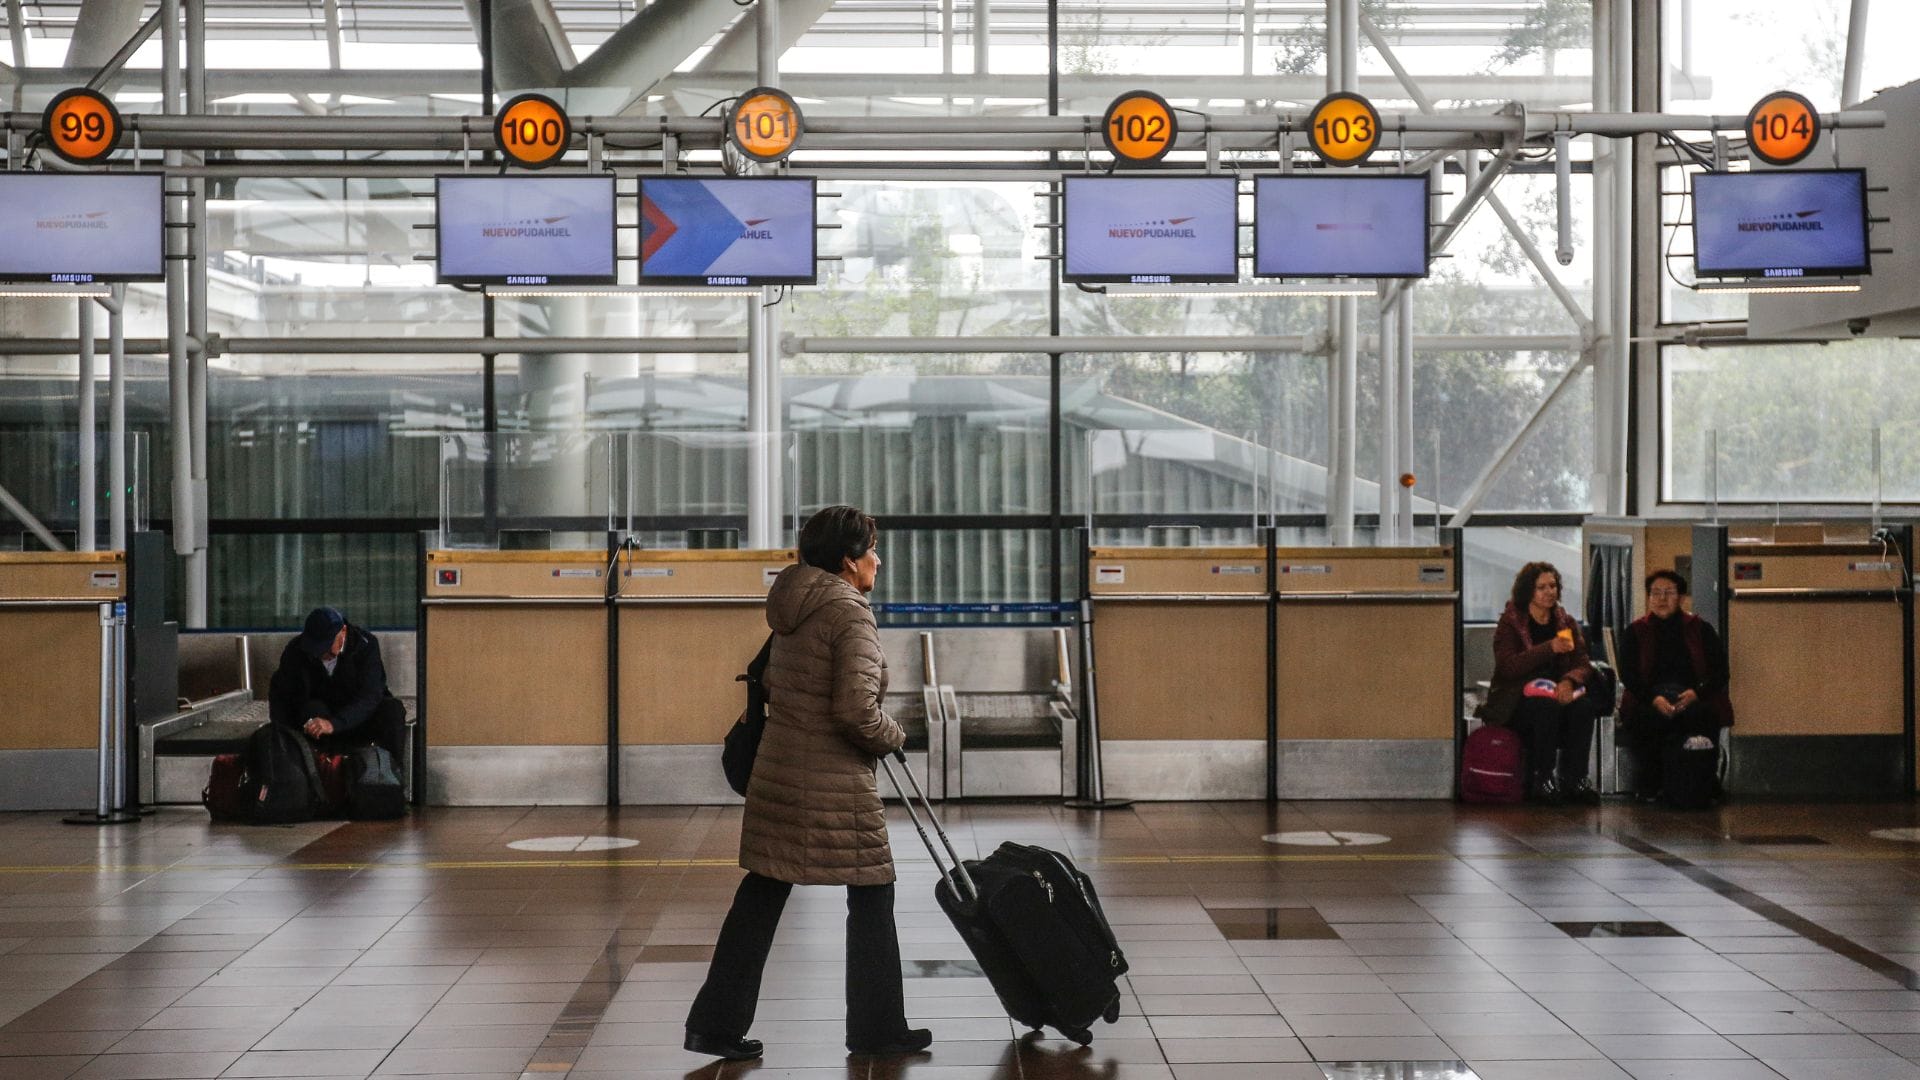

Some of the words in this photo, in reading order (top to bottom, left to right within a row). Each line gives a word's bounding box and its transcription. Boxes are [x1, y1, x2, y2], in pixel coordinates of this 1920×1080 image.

[60, 112, 105, 142] 99
[738, 112, 790, 139] 101
[1111, 114, 1165, 143] 102
[1316, 115, 1373, 145] 103
[1755, 114, 1809, 141] 104
[505, 118, 560, 146] 100
[36, 220, 109, 229] NUEVOPUDAHUEL
[1738, 221, 1823, 232] NUEVOPUDAHUEL
[482, 227, 571, 238] NUEVOPUDAHUEL
[1108, 228, 1196, 239] NUEVOPUDAHUEL
[51, 274, 93, 282] SAMSUNG
[1764, 268, 1804, 277] SAMSUNG
[506, 276, 548, 284] SAMSUNG
[707, 277, 748, 285] SAMSUNG
[1131, 275, 1171, 283] SAMSUNG
